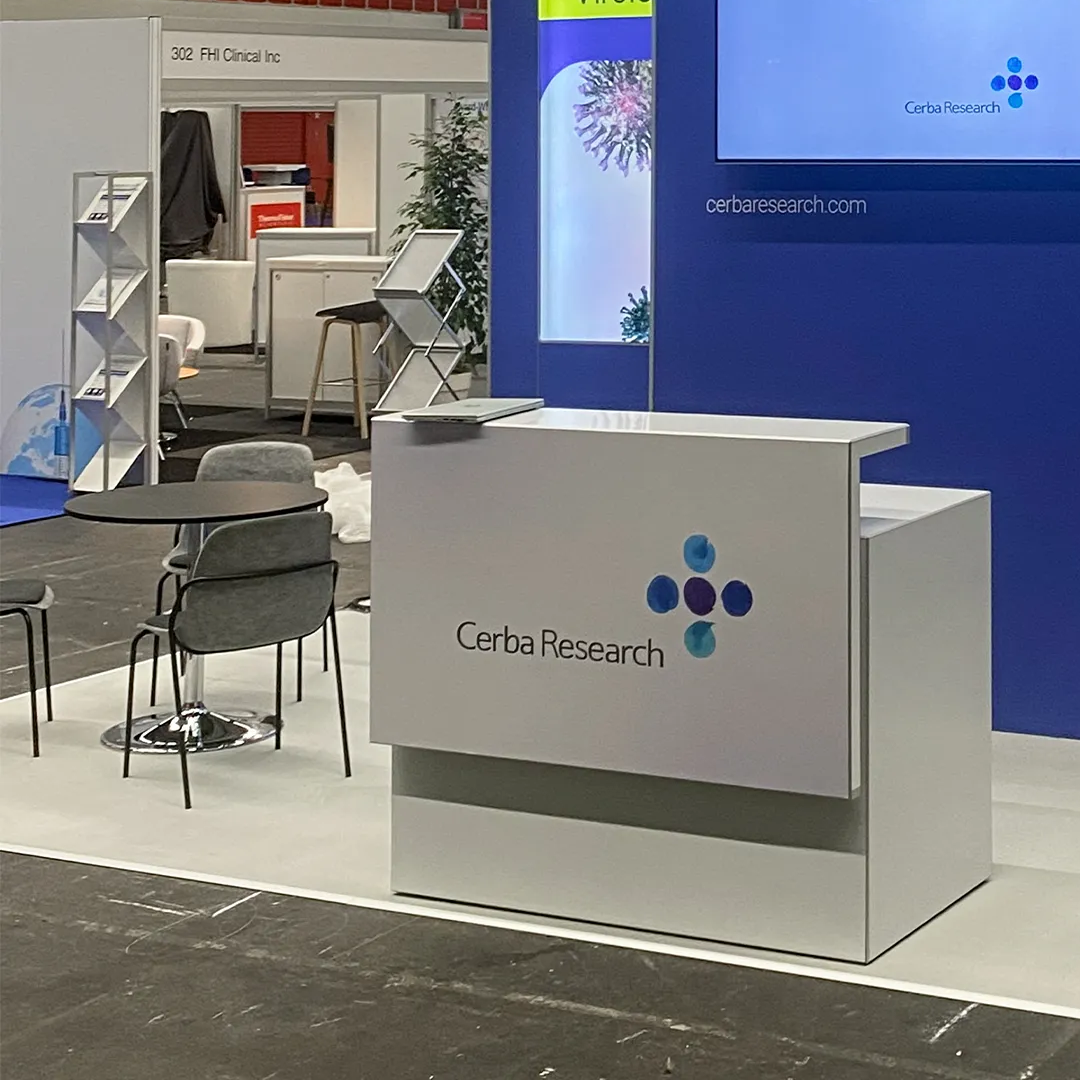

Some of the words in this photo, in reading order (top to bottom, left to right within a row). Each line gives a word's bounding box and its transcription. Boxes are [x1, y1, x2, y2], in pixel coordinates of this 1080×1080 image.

[171, 46, 193, 61] 302
[200, 47, 220, 61] FHI
[223, 48, 261, 62] Clinical
[265, 50, 281, 63] Inc
[905, 101, 942, 114] Cerba
[944, 101, 1000, 114] Research
[706, 195, 867, 214] cerbaresearch.com
[456, 621, 535, 656] Cerba
[541, 629, 664, 668] Research
